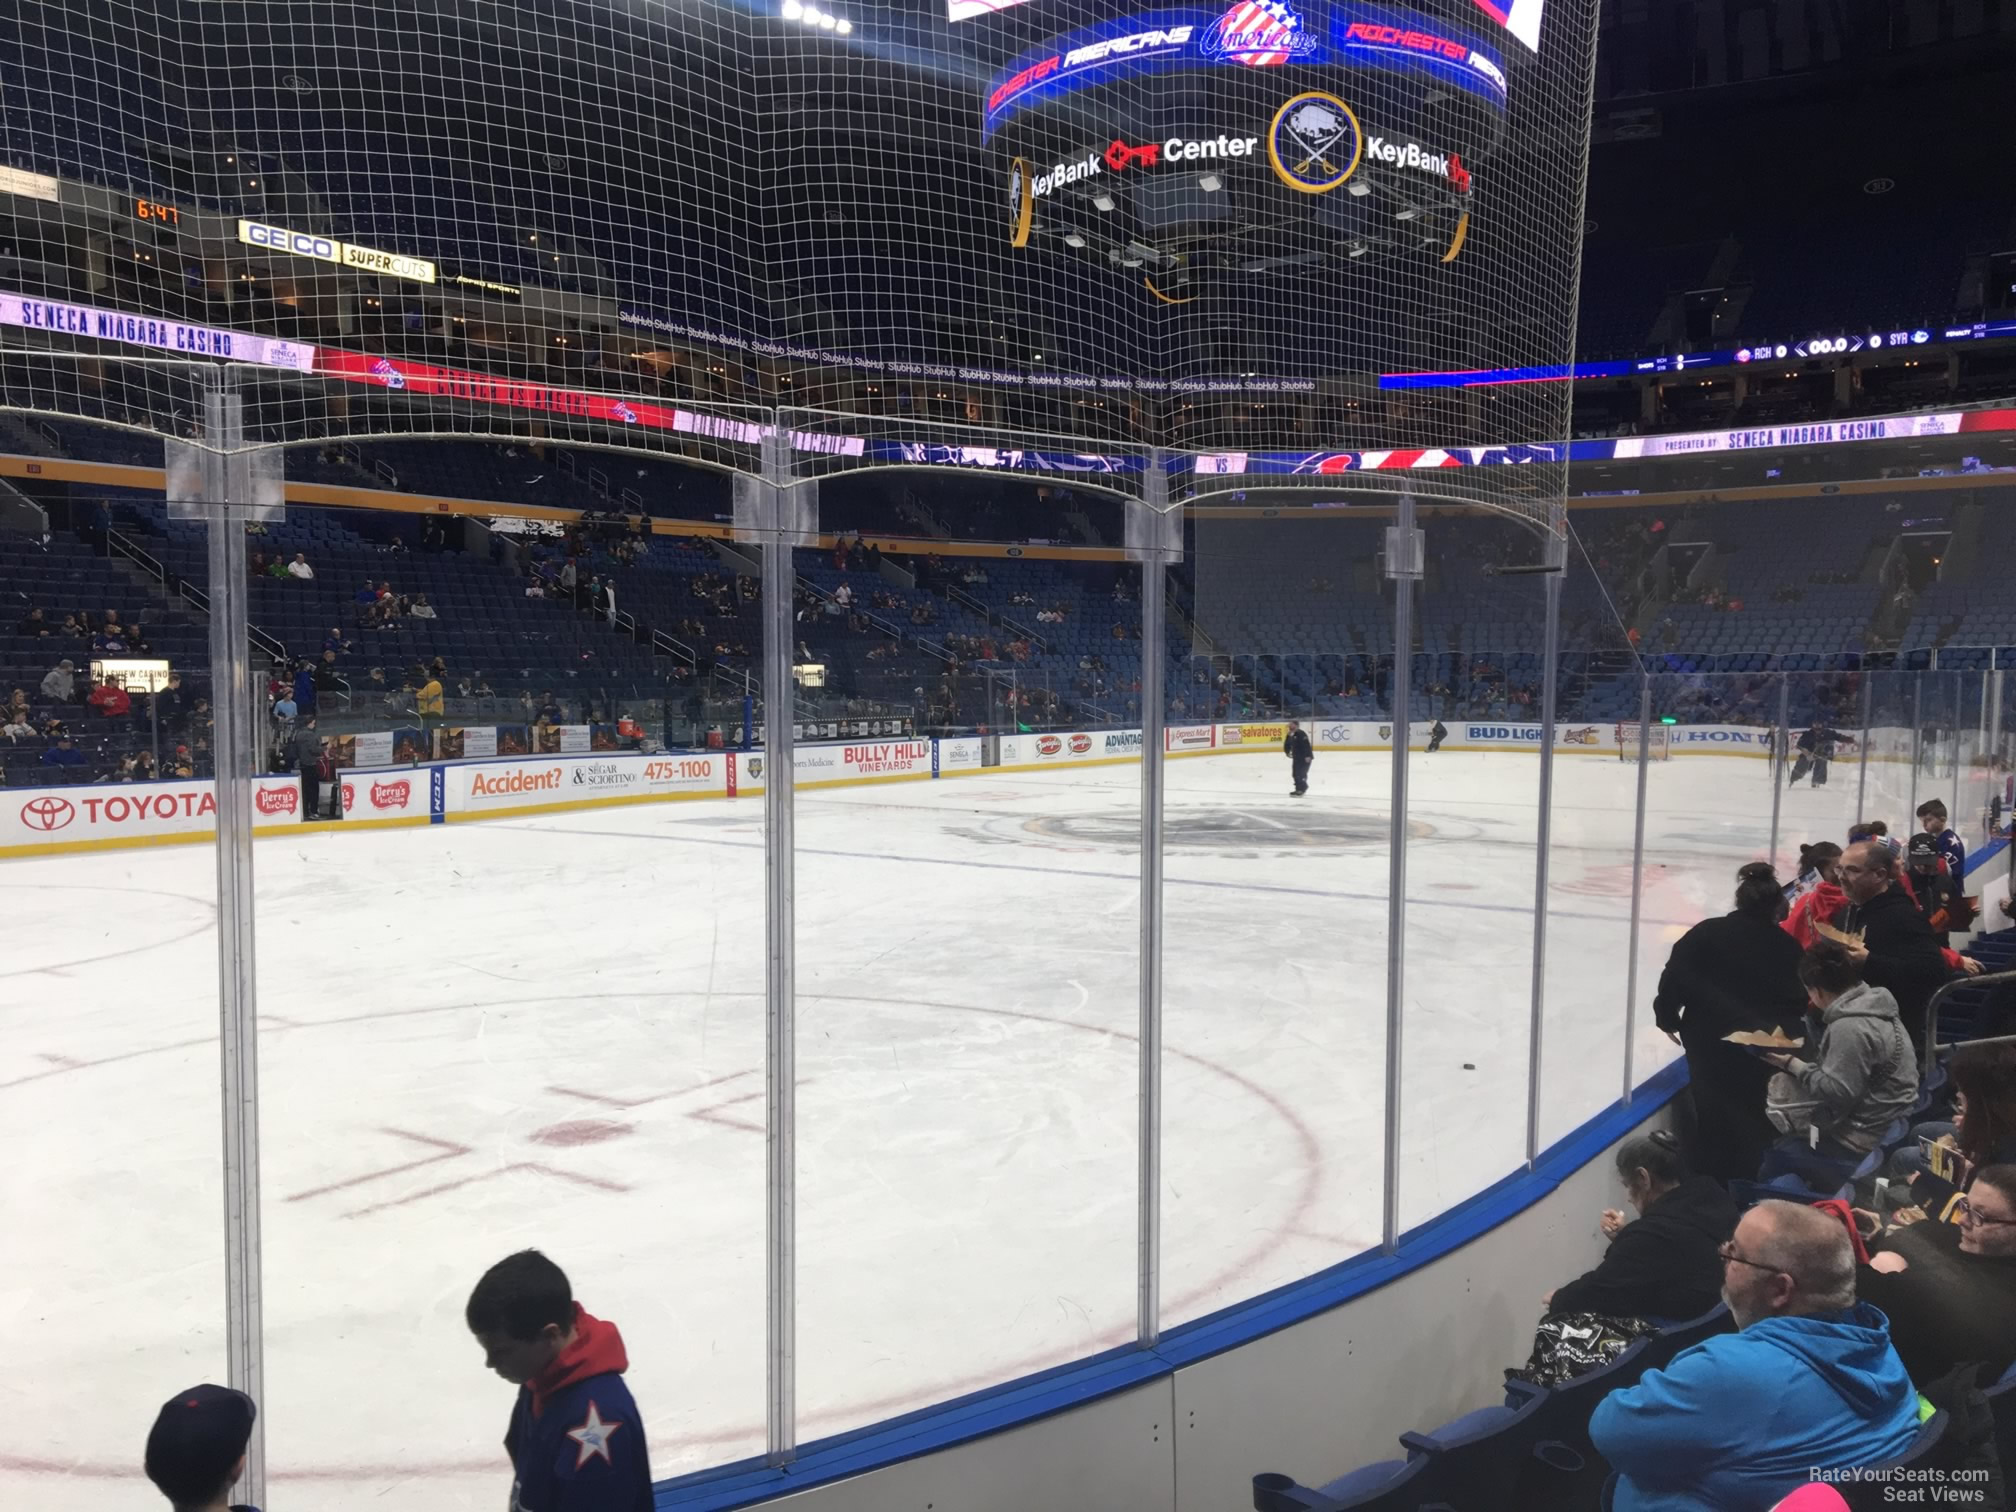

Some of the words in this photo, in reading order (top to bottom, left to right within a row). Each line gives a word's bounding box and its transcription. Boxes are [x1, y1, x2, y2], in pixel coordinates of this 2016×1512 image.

[1063, 26, 1193, 68] AMERICANS
[1199, 13, 1318, 58] Americans
[1346, 23, 1467, 61] ROCHESTER
[1031, 154, 1101, 199] KeyBank
[1163, 135, 1257, 162] Center
[1367, 136, 1449, 177] KeyBank
[137, 200, 179, 225] 6:47
[249, 224, 333, 259] GEICO
[348, 249, 427, 278] SUPERCUTS
[486, 282, 521, 295] SPORTS
[22, 301, 90, 334] SENECA
[98, 313, 169, 346] NIAGARA
[177, 326, 232, 357] CASINO
[619, 311, 653, 327] StubHub
[655, 319, 686, 334] StubHub
[687, 327, 718, 342] StubHub
[719, 334, 748, 348] StubHub
[752, 341, 784, 354] StubHub
[787, 346, 818, 360] StubHub
[822, 352, 853, 365] StubHub
[855, 357, 884, 370] StubHub
[888, 362, 921, 374] StubHub
[924, 366, 956, 377] StubHub
[959, 369, 990, 381] StubHub
[993, 372, 1023, 384] StubHub
[1028, 375, 1061, 385] StubHub
[1064, 376, 1096, 387] StubHub
[1100, 378, 1133, 389] StubHub
[1135, 380, 1167, 390] StubHub
[1171, 381, 1206, 391] StubHub
[1208, 381, 1242, 391] StubHub
[1244, 381, 1279, 391] StubHub
[1281, 381, 1316, 390] StubHub
[1754, 347, 1772, 360] RCH
[1776, 345, 1788, 358] 0
[1809, 337, 1848, 355] 00.0
[1869, 335, 1882, 348] 0
[1889, 332, 1909, 345] SYR
[1665, 439, 1704, 450] PRESENTED
[1707, 438, 1717, 448] BY
[1728, 430, 1774, 449] SENECA
[1780, 425, 1832, 445] NIAGARA
[1840, 421, 1885, 440] CASINO
[1215, 458, 1227, 472] VS
[138, 670, 168, 679] CASINO
[1105, 734, 1142, 747] ADVANTAG
[1469, 728, 1507, 738] BUD
[807, 758, 834, 768] Medicine
[844, 745, 890, 763] BULLY
[894, 743, 925, 759] HILL
[573, 768, 584, 784] &
[645, 760, 711, 780] 475-1100
[858, 760, 913, 772] VINEYARDS
[472, 767, 563, 796] Accident?
[588, 773, 635, 785] SCIORTINO
[260, 792, 294, 806] Perry's
[375, 786, 406, 799] Perry's
[82, 793, 216, 823] TOYOTA
